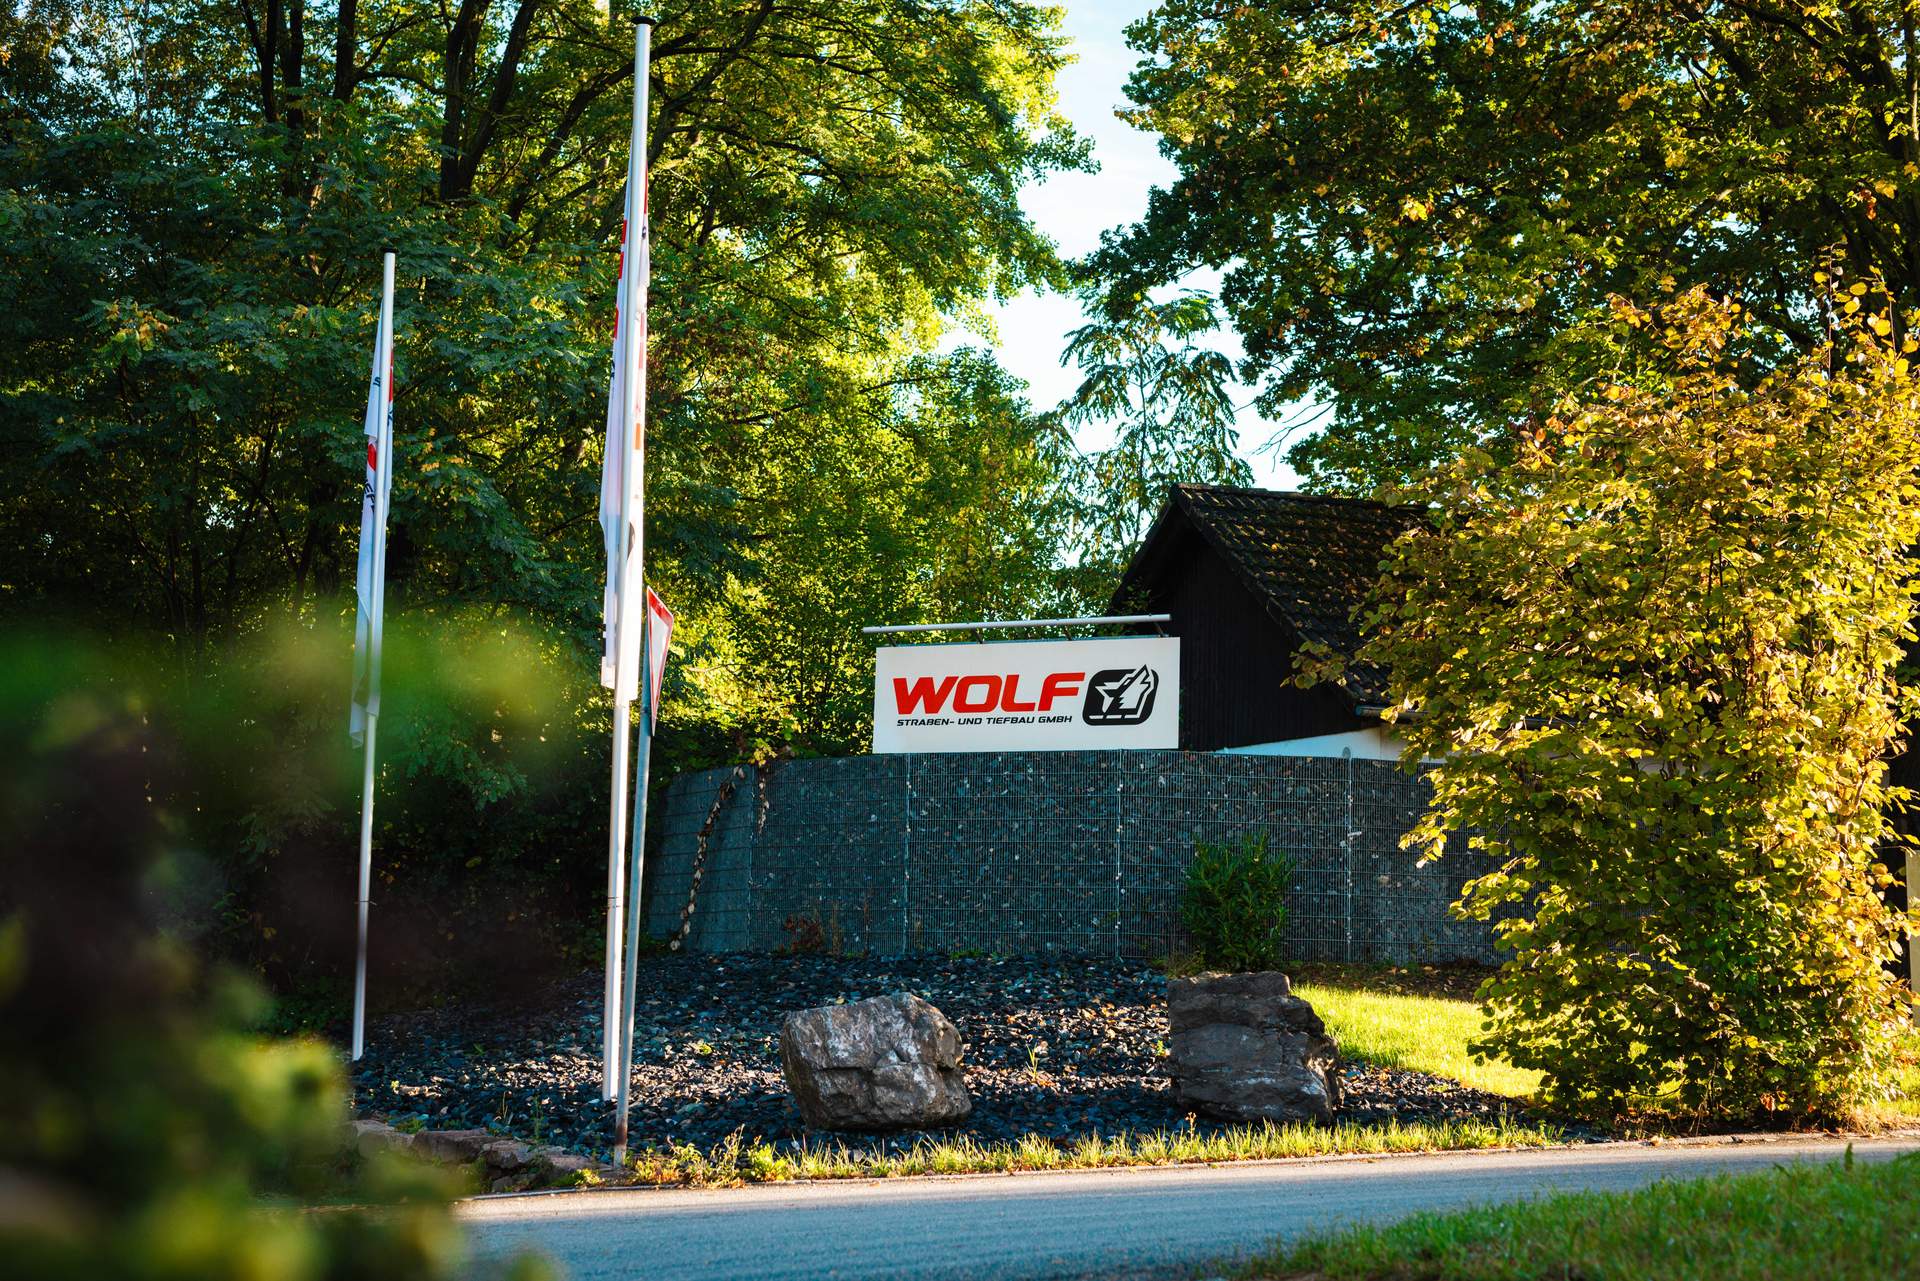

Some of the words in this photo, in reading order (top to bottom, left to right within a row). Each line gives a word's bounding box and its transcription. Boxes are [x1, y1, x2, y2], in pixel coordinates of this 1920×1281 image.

[893, 672, 1086, 715] WOLF
[957, 717, 983, 725] UND
[986, 716, 1035, 724] TIEFBAU
[1038, 715, 1073, 723] GMBH
